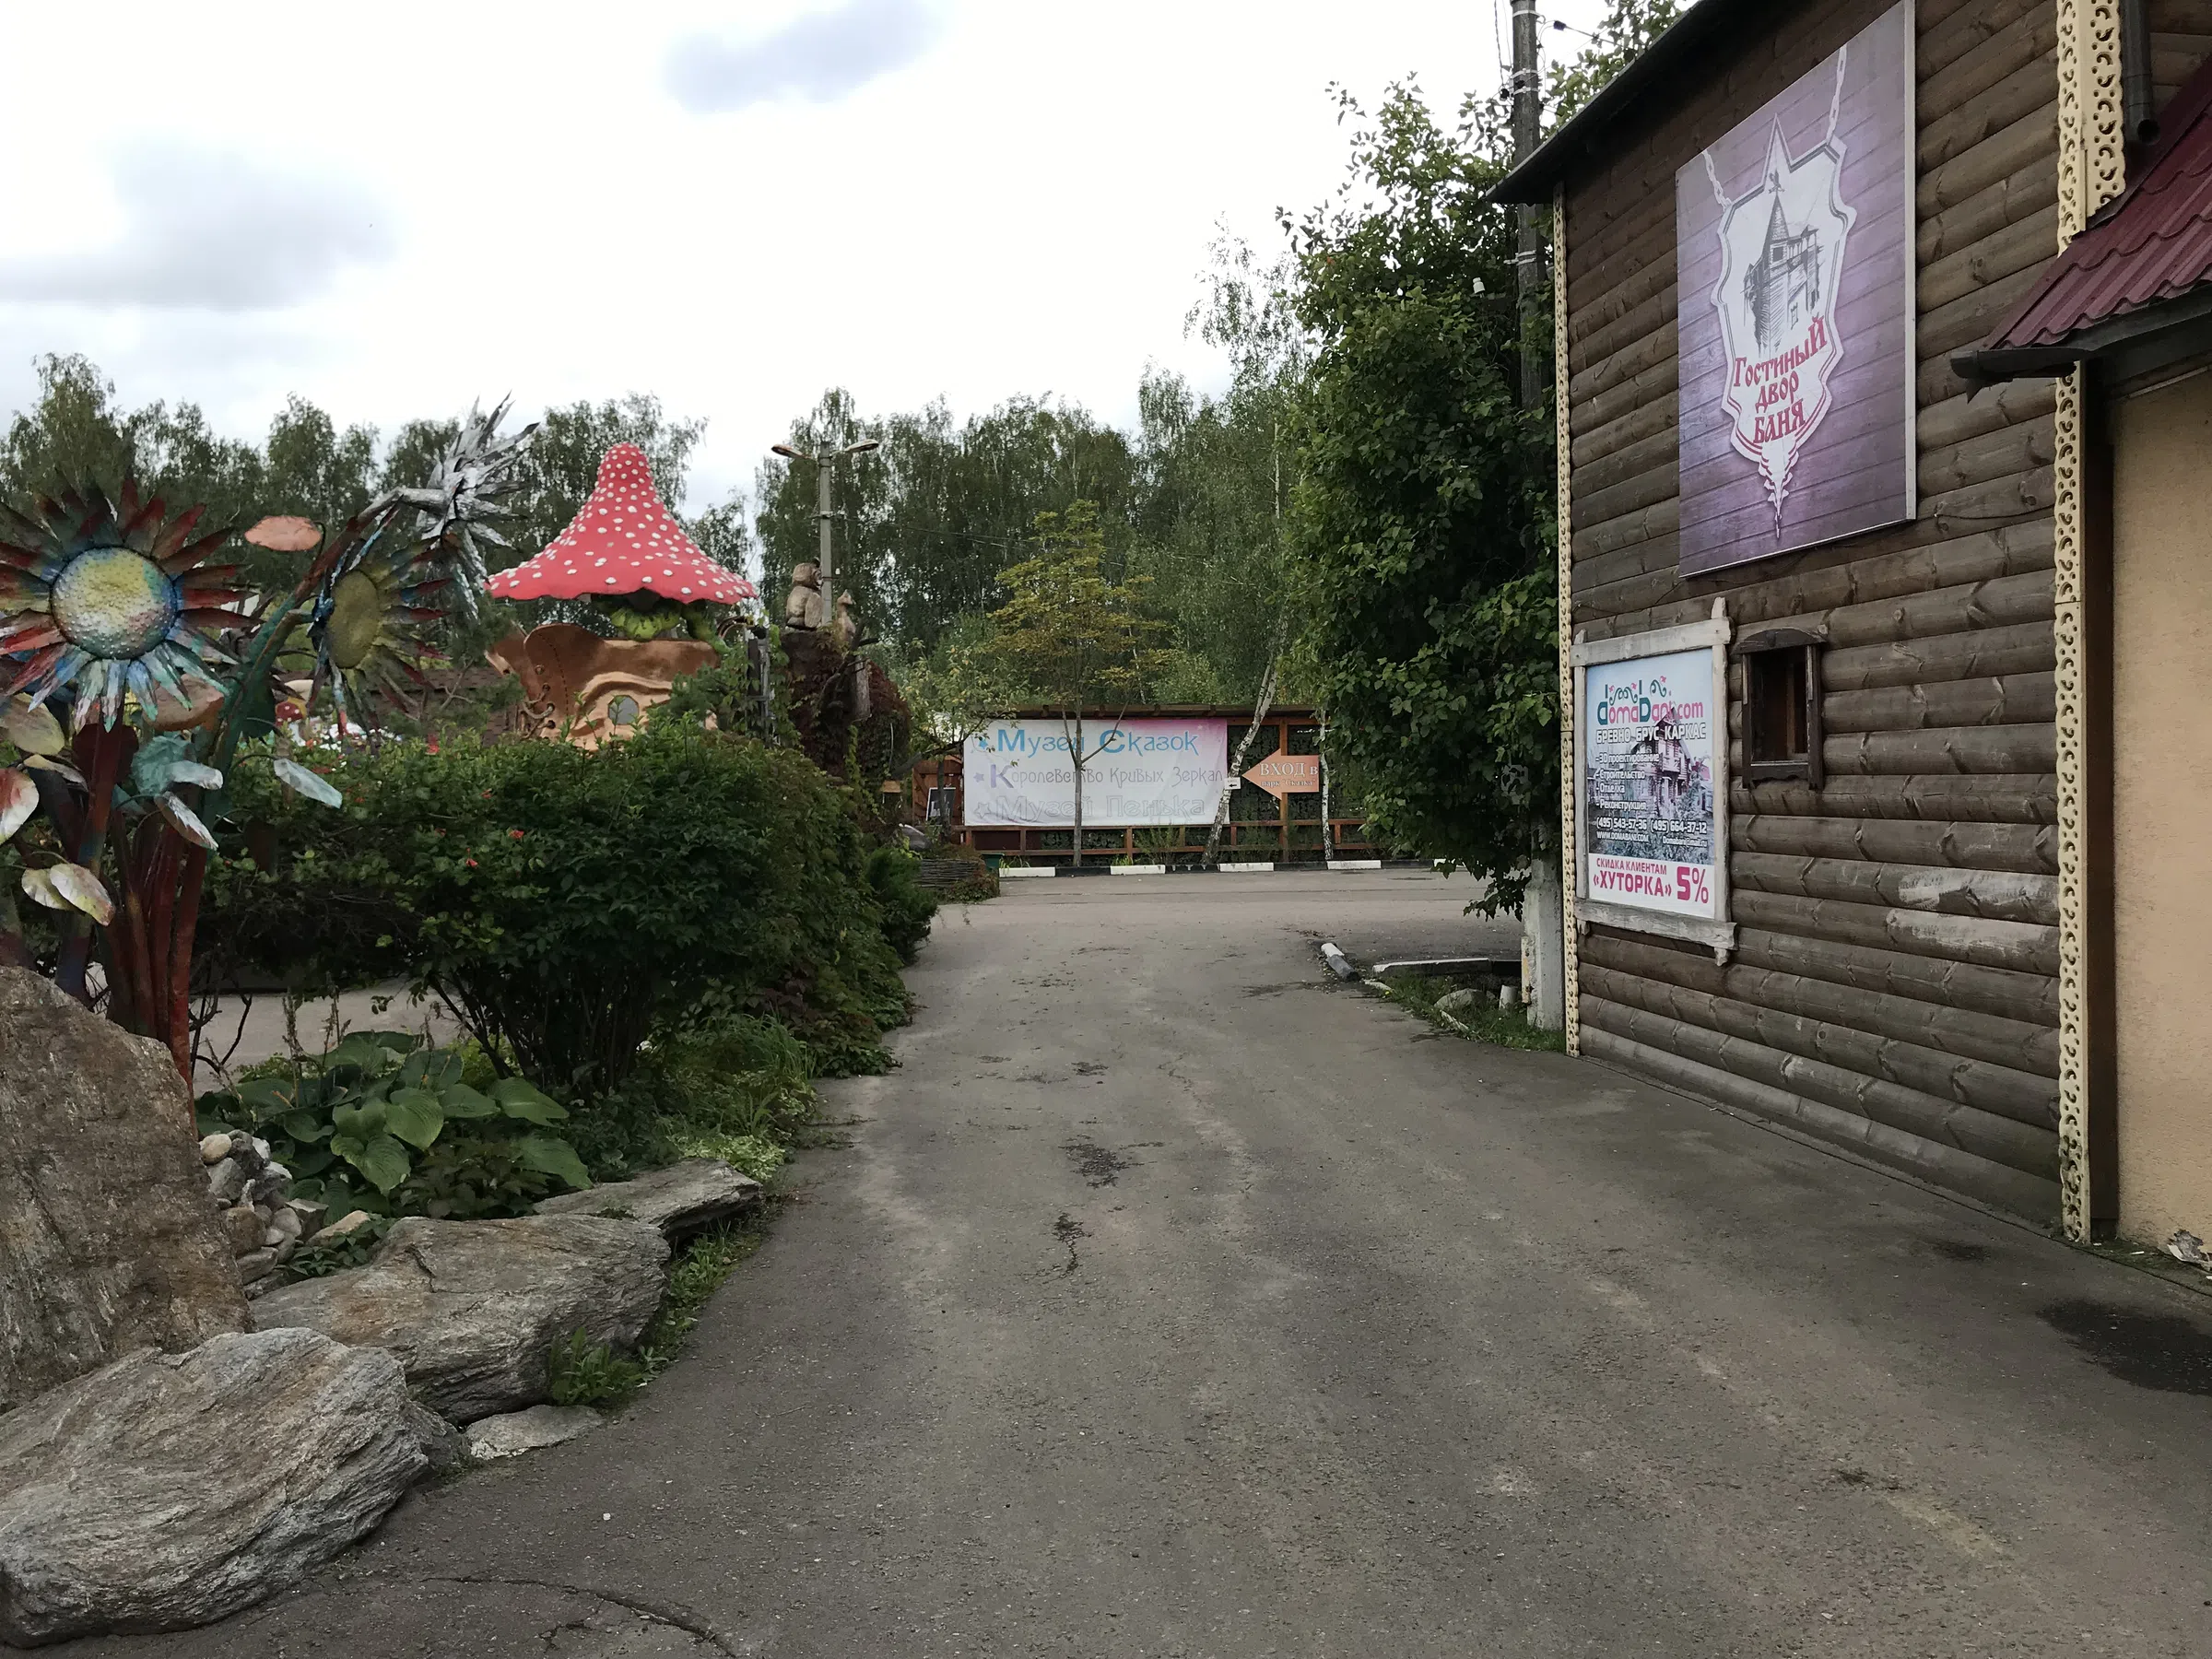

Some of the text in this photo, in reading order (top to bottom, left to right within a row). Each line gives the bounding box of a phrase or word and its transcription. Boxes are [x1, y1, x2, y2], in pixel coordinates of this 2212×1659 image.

[1596, 723, 1706, 744] БРЕВНО БРУС КАРКАС
[1099, 729, 1198, 756] Сказок
[1608, 753, 1660, 765] проектирование
[1110, 768, 1164, 789] Кривых
[1171, 766, 1223, 787] Зеркал
[1260, 762, 1319, 778] ВХОД в
[1600, 769, 1645, 781] Строительство
[1600, 782, 1625, 794] Отделка
[1106, 794, 1205, 821] Пенька
[1600, 799, 1646, 811] Реконструкция
[1596, 817, 1707, 834] (495) 543-57-36 (495) 664-37-12
[1596, 857, 1667, 875] СКИДКА КЛИЕНТАМ
[1593, 866, 1710, 904] «ХУТОРКА» 5%
